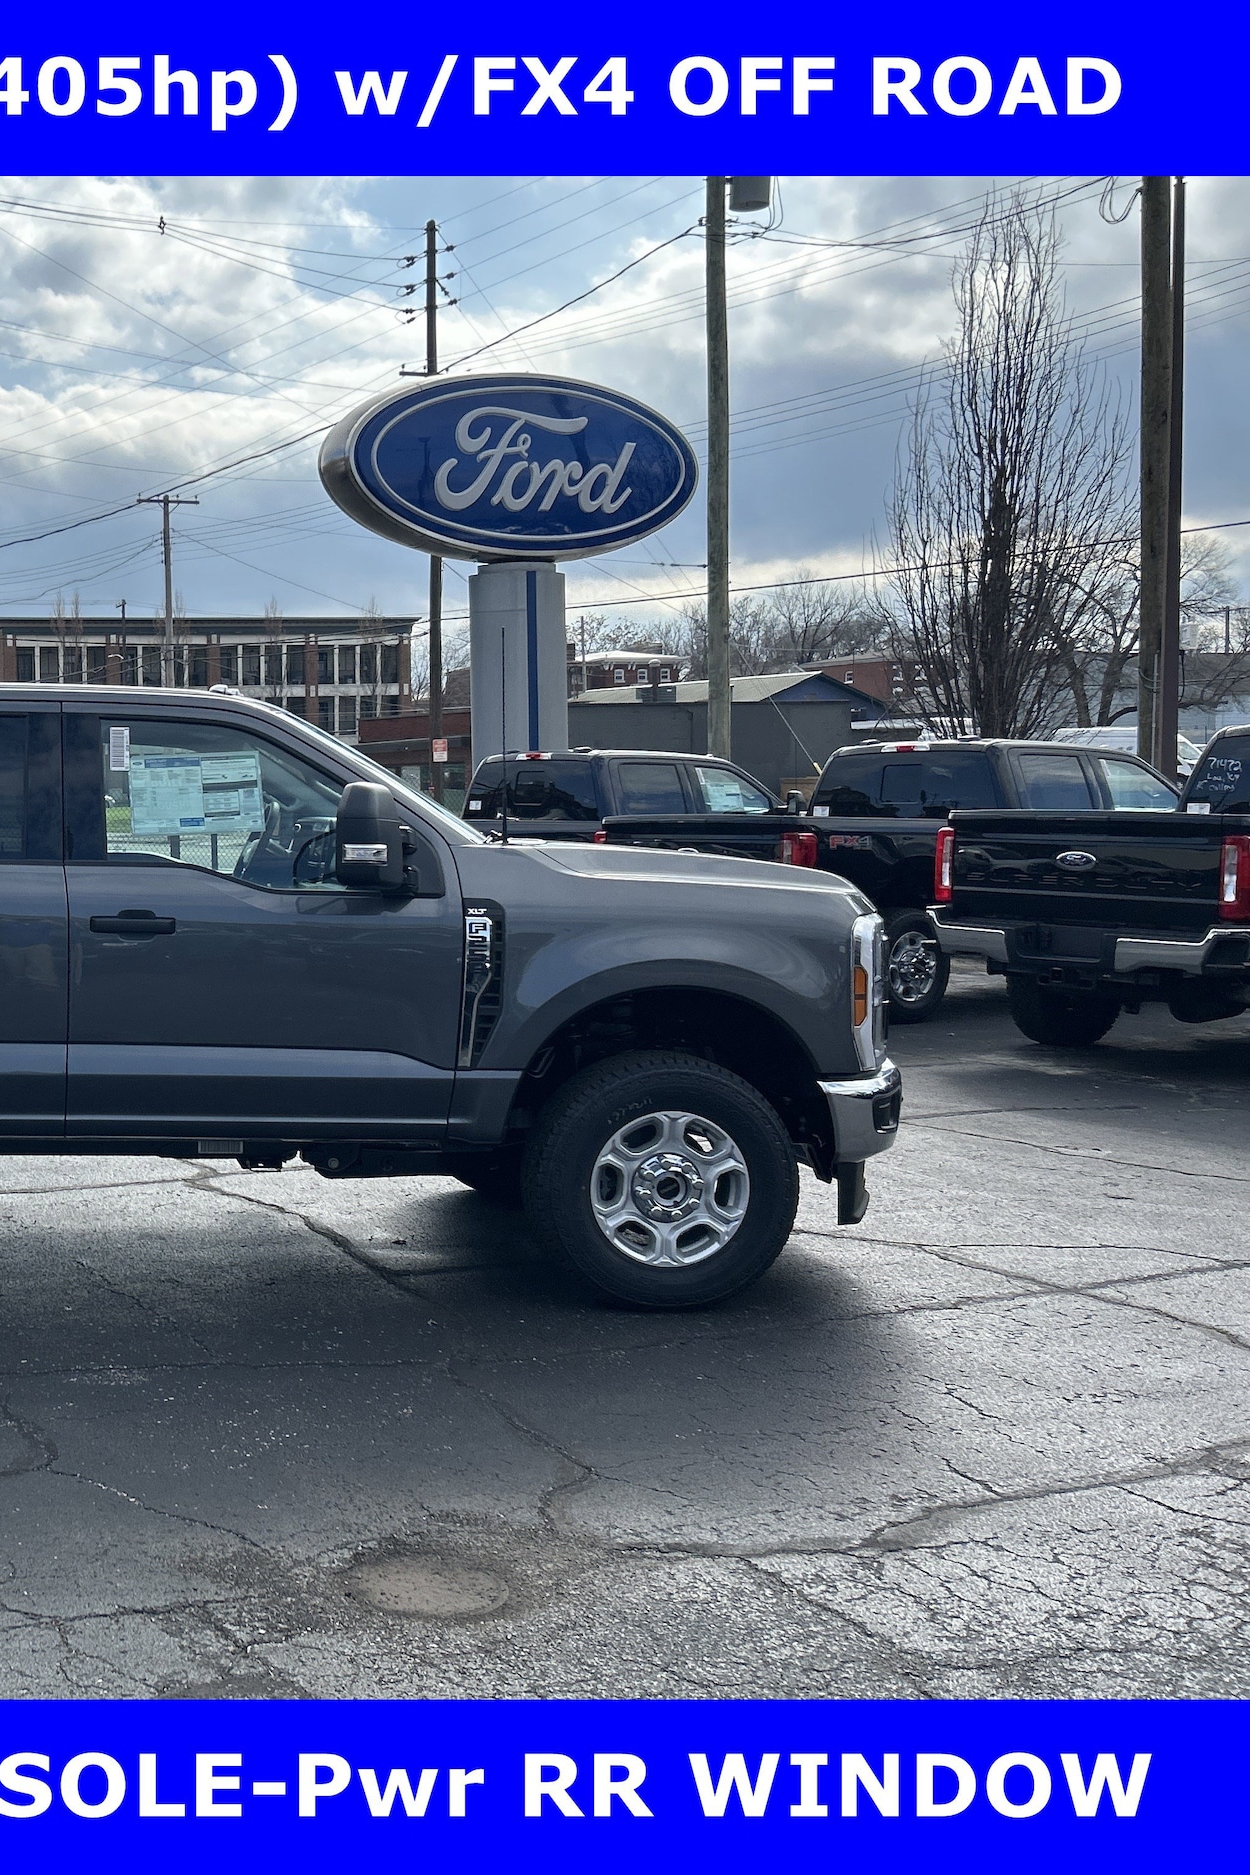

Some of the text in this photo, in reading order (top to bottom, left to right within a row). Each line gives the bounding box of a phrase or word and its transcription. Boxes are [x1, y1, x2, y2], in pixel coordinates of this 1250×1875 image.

[434, 406, 637, 514] Ford
[1207, 757, 1243, 772] 71472
[829, 835, 872, 850] FX4
